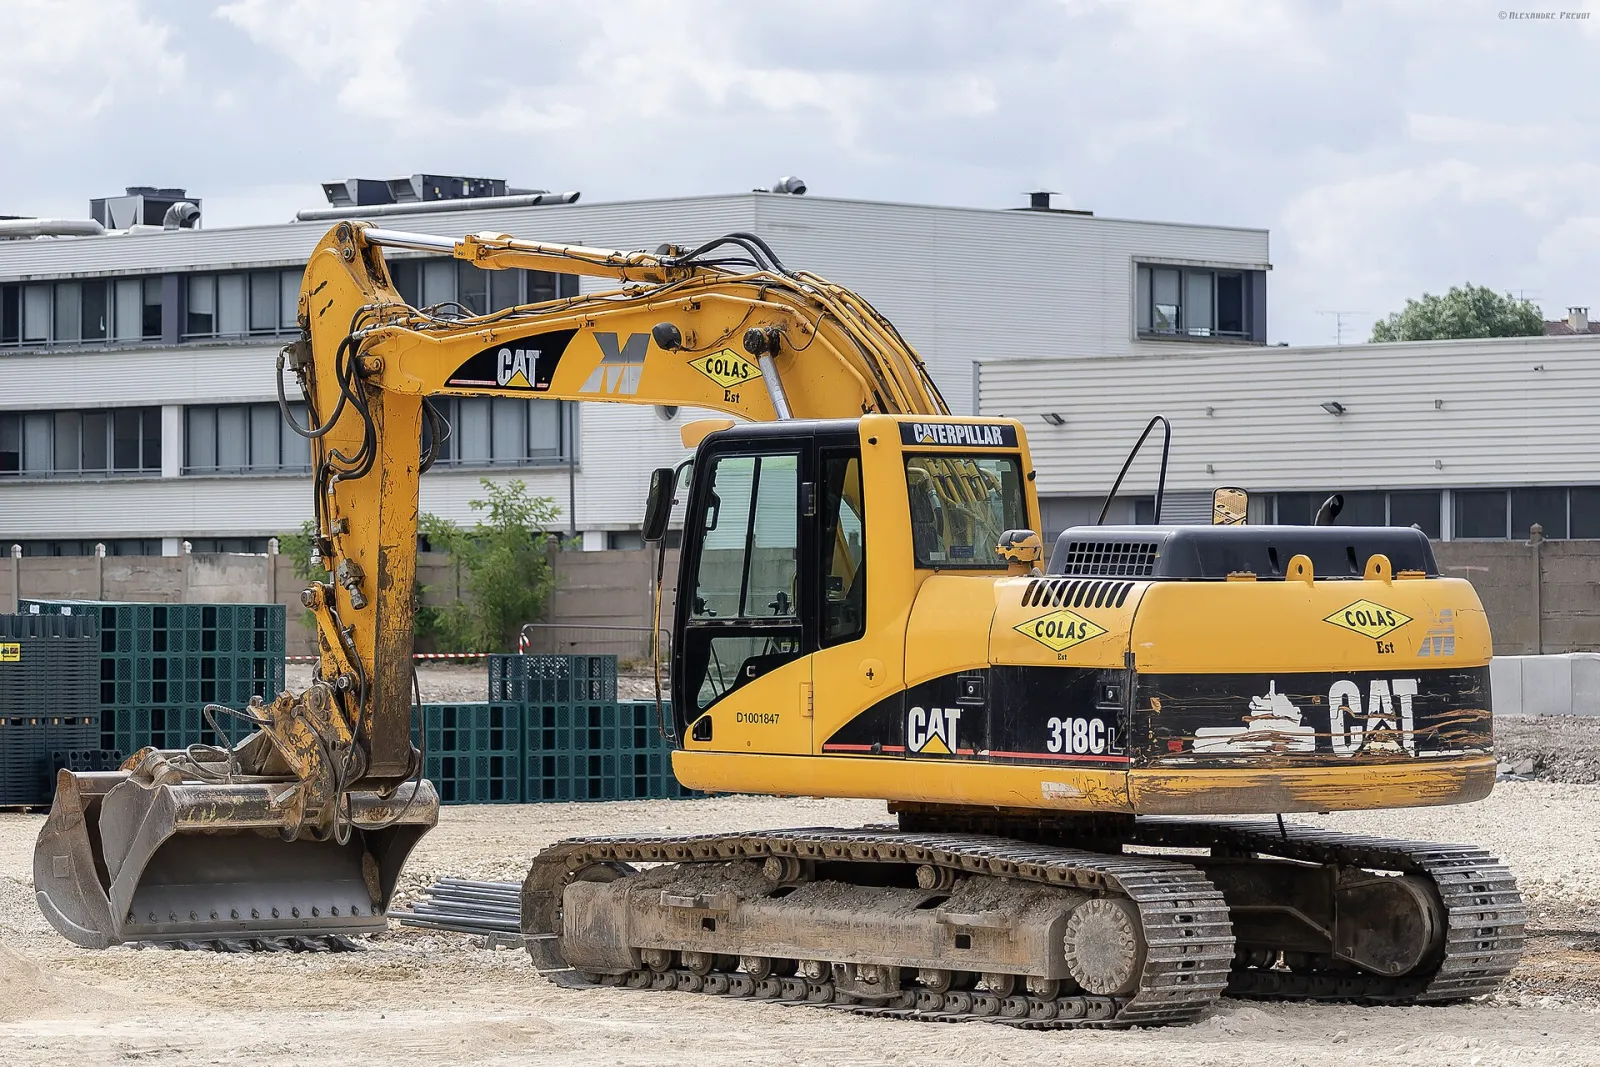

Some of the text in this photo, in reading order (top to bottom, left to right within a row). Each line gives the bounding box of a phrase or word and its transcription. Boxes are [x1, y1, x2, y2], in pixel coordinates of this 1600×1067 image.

[497, 348, 541, 387] CAT
[705, 358, 748, 378] COLAS
[723, 389, 740, 403] Est
[913, 424, 1004, 445] CATERPILLAR
[1344, 610, 1396, 628] COLAS
[1035, 620, 1087, 640] COLAS
[1057, 653, 1067, 661] Est
[1376, 641, 1394, 654] Est
[736, 712, 780, 724] D1001847
[1328, 679, 1422, 758] CAT
[908, 706, 962, 754] CAT
